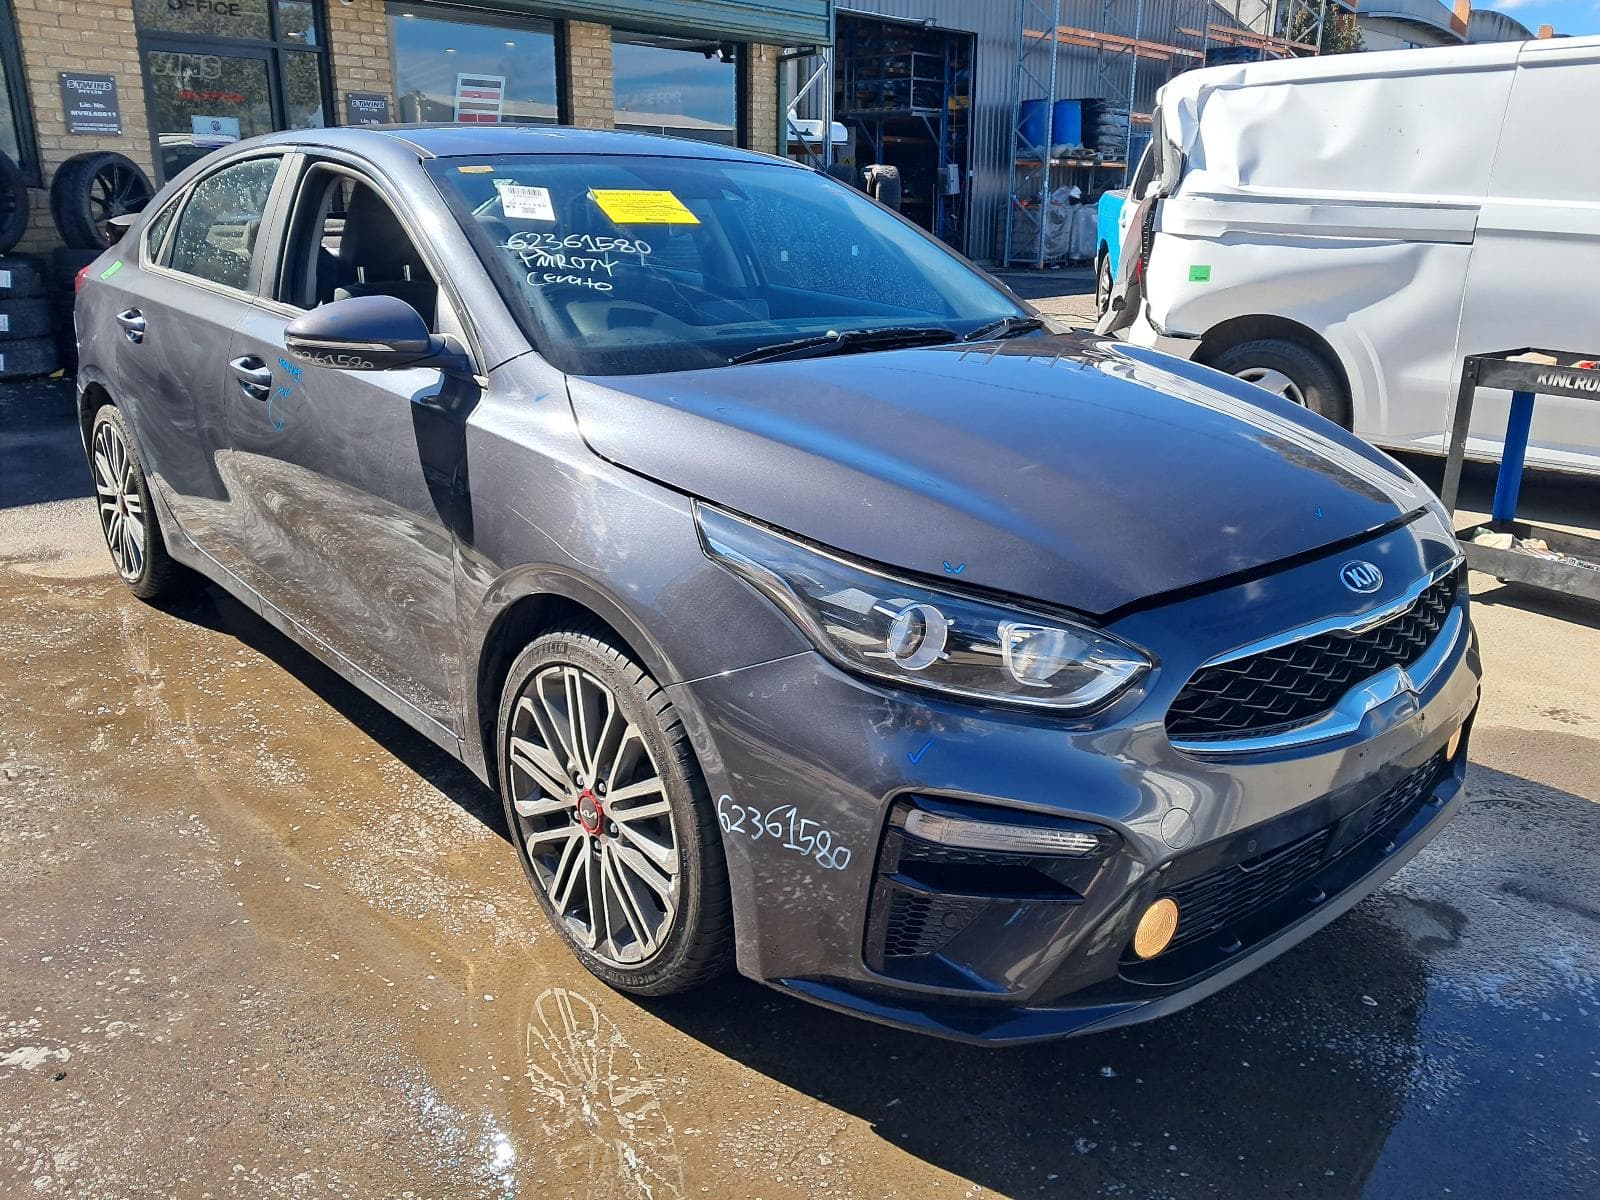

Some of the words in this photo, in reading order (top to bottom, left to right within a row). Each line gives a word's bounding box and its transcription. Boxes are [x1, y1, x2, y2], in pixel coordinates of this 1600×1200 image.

[507, 231, 652, 254] 62361580
[526, 271, 613, 291] Cerato
[1345, 562, 1380, 588] KIA
[718, 794, 851, 870] 62361580
